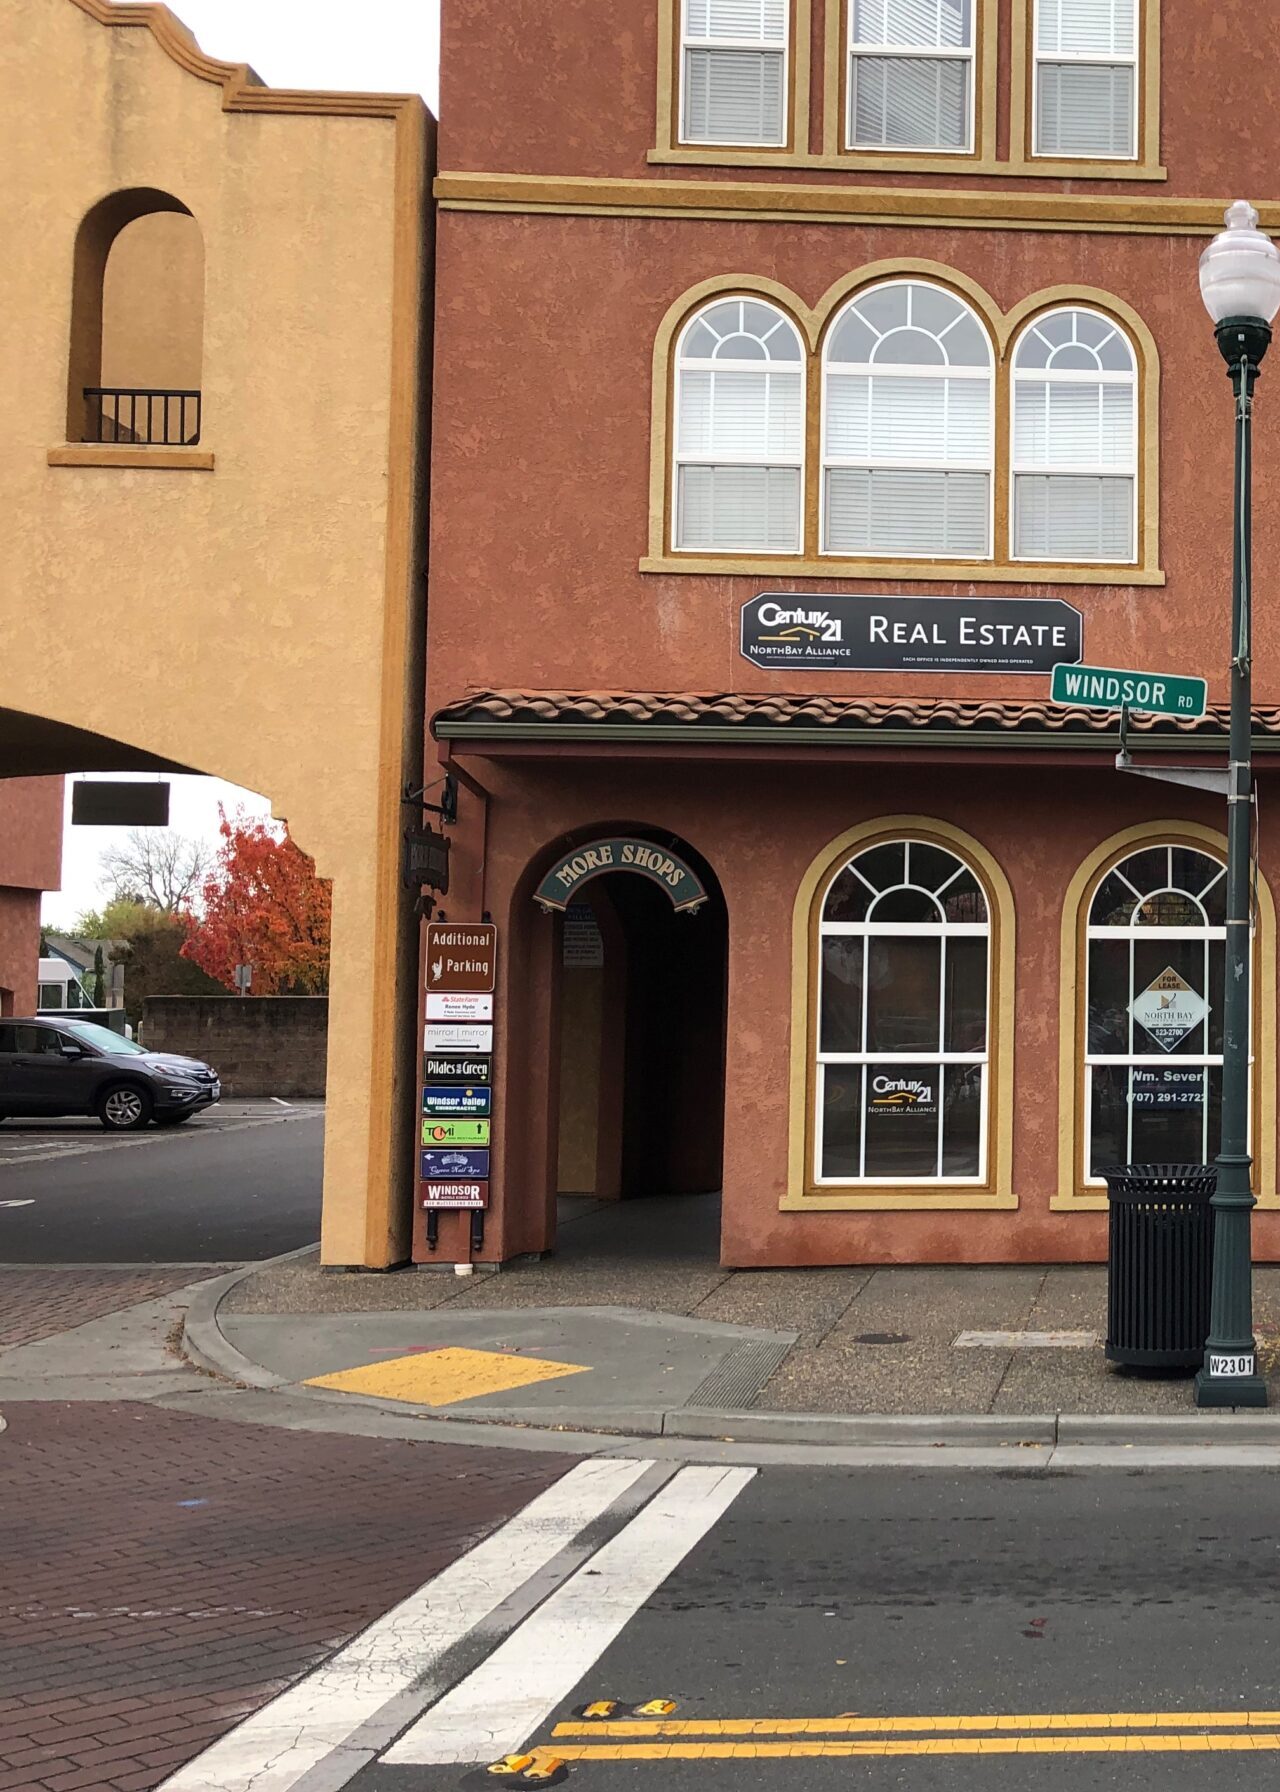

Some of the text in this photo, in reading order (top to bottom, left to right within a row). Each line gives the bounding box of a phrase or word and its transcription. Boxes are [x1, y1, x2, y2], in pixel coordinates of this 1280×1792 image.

[820, 619, 843, 642] 21
[869, 615, 1067, 647] REAL ESTATE
[805, 645, 852, 657] ALLIANCE
[1065, 673, 1193, 709] WINDSOR RD
[555, 844, 686, 888] MORE SHOPS
[432, 932, 490, 946] Additional
[446, 958, 489, 976] Parking
[428, 1028, 454, 1036] mirror
[427, 1060, 455, 1074] Pilates
[463, 1061, 488, 1075] Green
[426, 1096, 486, 1107] Windsor Valley
[916, 1086, 932, 1103] 21
[428, 1185, 480, 1200] WINDSOR
[1210, 1357, 1252, 1374] W2301
